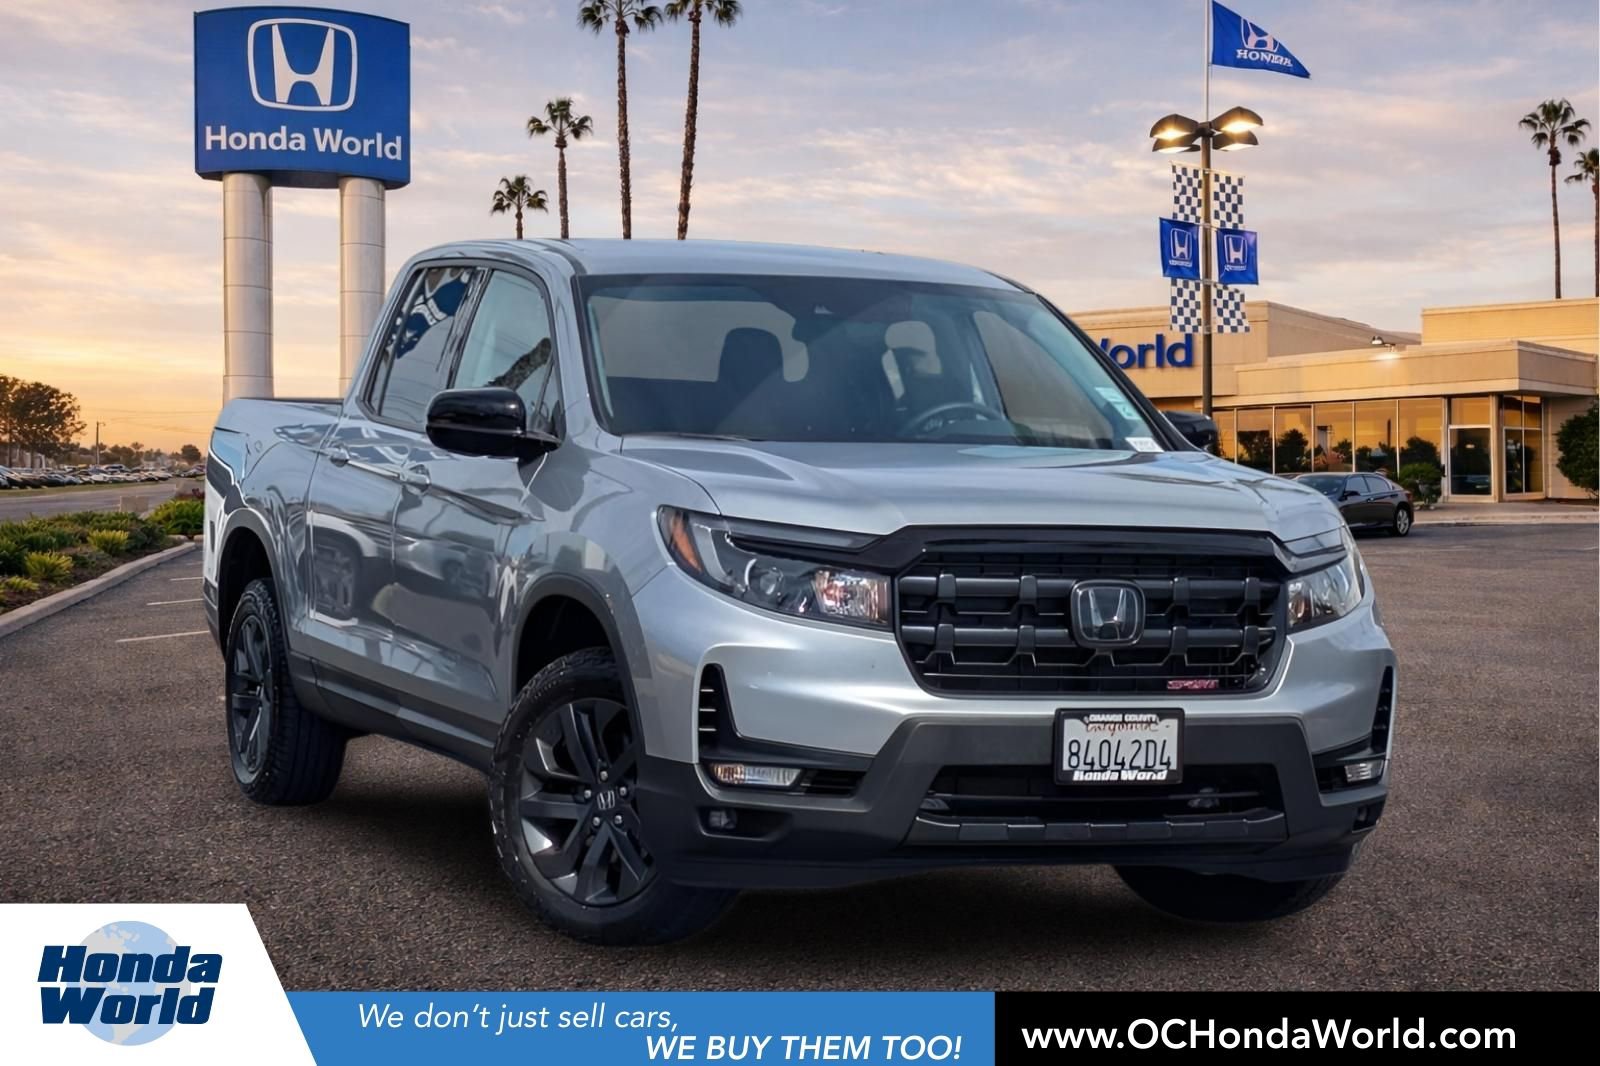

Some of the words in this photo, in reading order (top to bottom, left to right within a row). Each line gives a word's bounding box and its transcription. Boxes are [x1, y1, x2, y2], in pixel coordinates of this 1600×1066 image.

[1236, 49, 1293, 67] HONDA
[205, 125, 306, 151] Honda
[313, 128, 402, 161] World
[1100, 333, 1193, 370] orld
[1124, 713, 1158, 722] COUNTY
[1068, 739, 1171, 771] 84042D4
[1072, 770, 1119, 781] Honda
[1120, 770, 1168, 781] World
